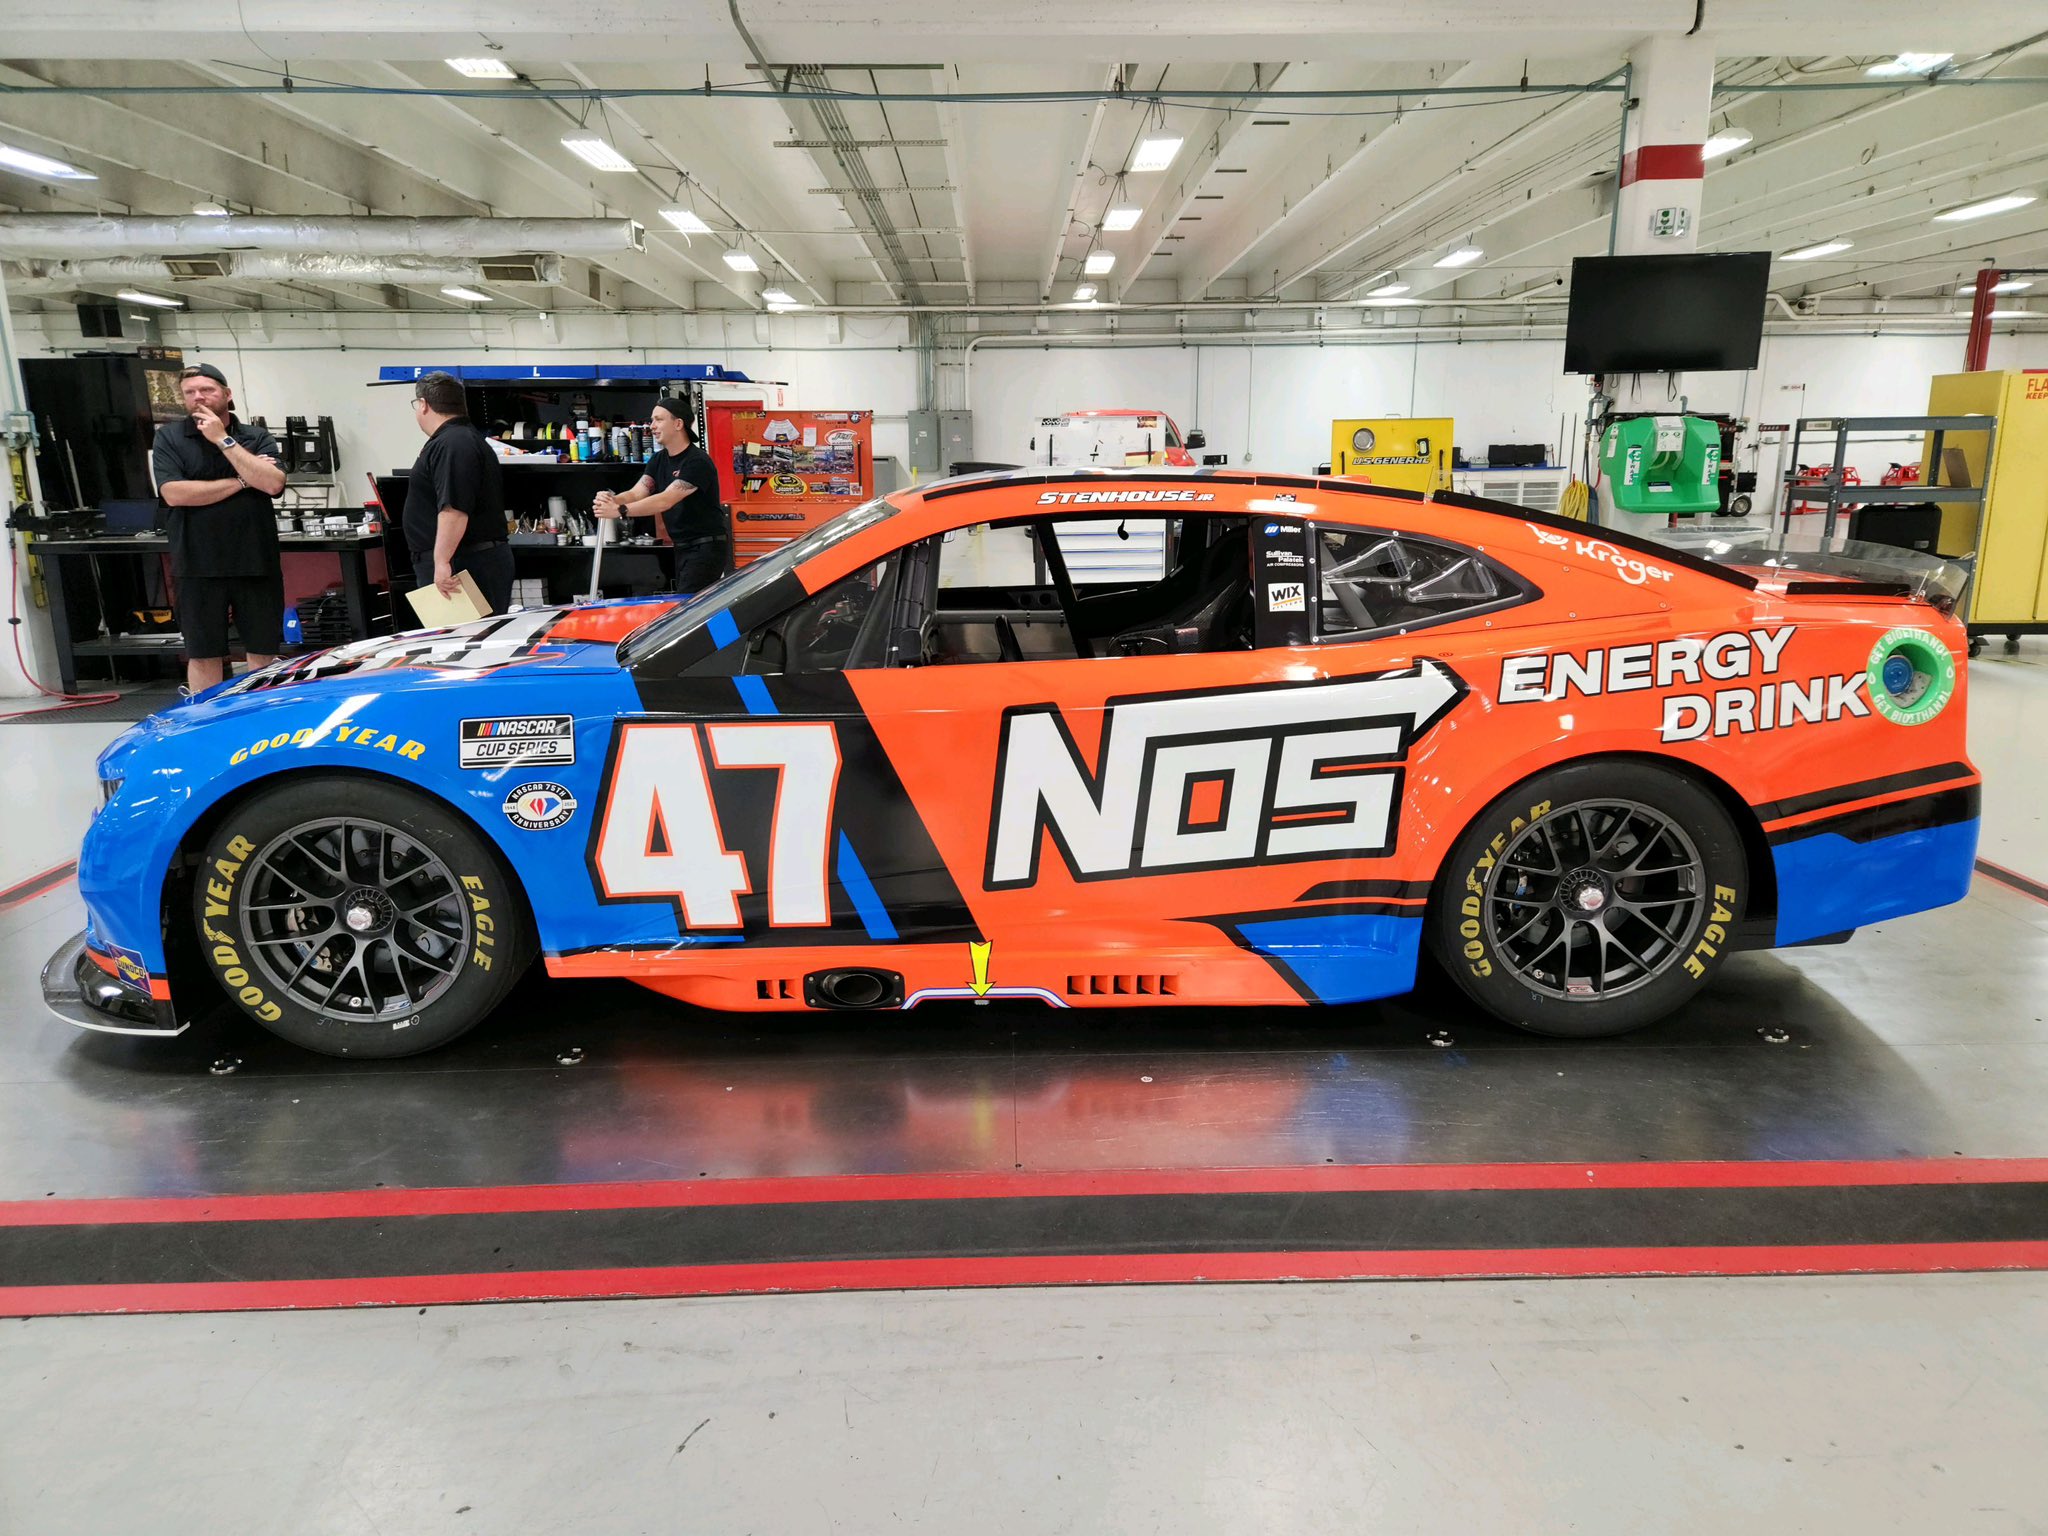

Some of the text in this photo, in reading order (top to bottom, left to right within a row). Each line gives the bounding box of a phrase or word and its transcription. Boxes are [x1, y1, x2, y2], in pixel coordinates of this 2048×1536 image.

[413, 367, 421, 378] F
[533, 366, 540, 377] L
[706, 365, 714, 376] R
[1036, 490, 1216, 505] STENHOUSE JR
[1280, 525, 1302, 533] Miller
[1575, 540, 1675, 585] Kroger
[1271, 585, 1301, 602] WIX
[1871, 642, 1886, 664] GET
[1498, 624, 1798, 704] ENERGY
[1661, 671, 1871, 743] DRINK
[1873, 693, 1892, 714] GET
[496, 720, 557, 736] NASCAR
[476, 741, 558, 757] CUP SERIES
[511, 783, 568, 800] NASCAR 75TH
[985, 674, 1438, 889] NOS
[512, 809, 570, 829] ANNIVERSARY
[594, 721, 843, 929] 47
[460, 874, 495, 972] EAGLE
[1682, 884, 1737, 980] EAGLE
[115, 958, 146, 979] SUNOCO
